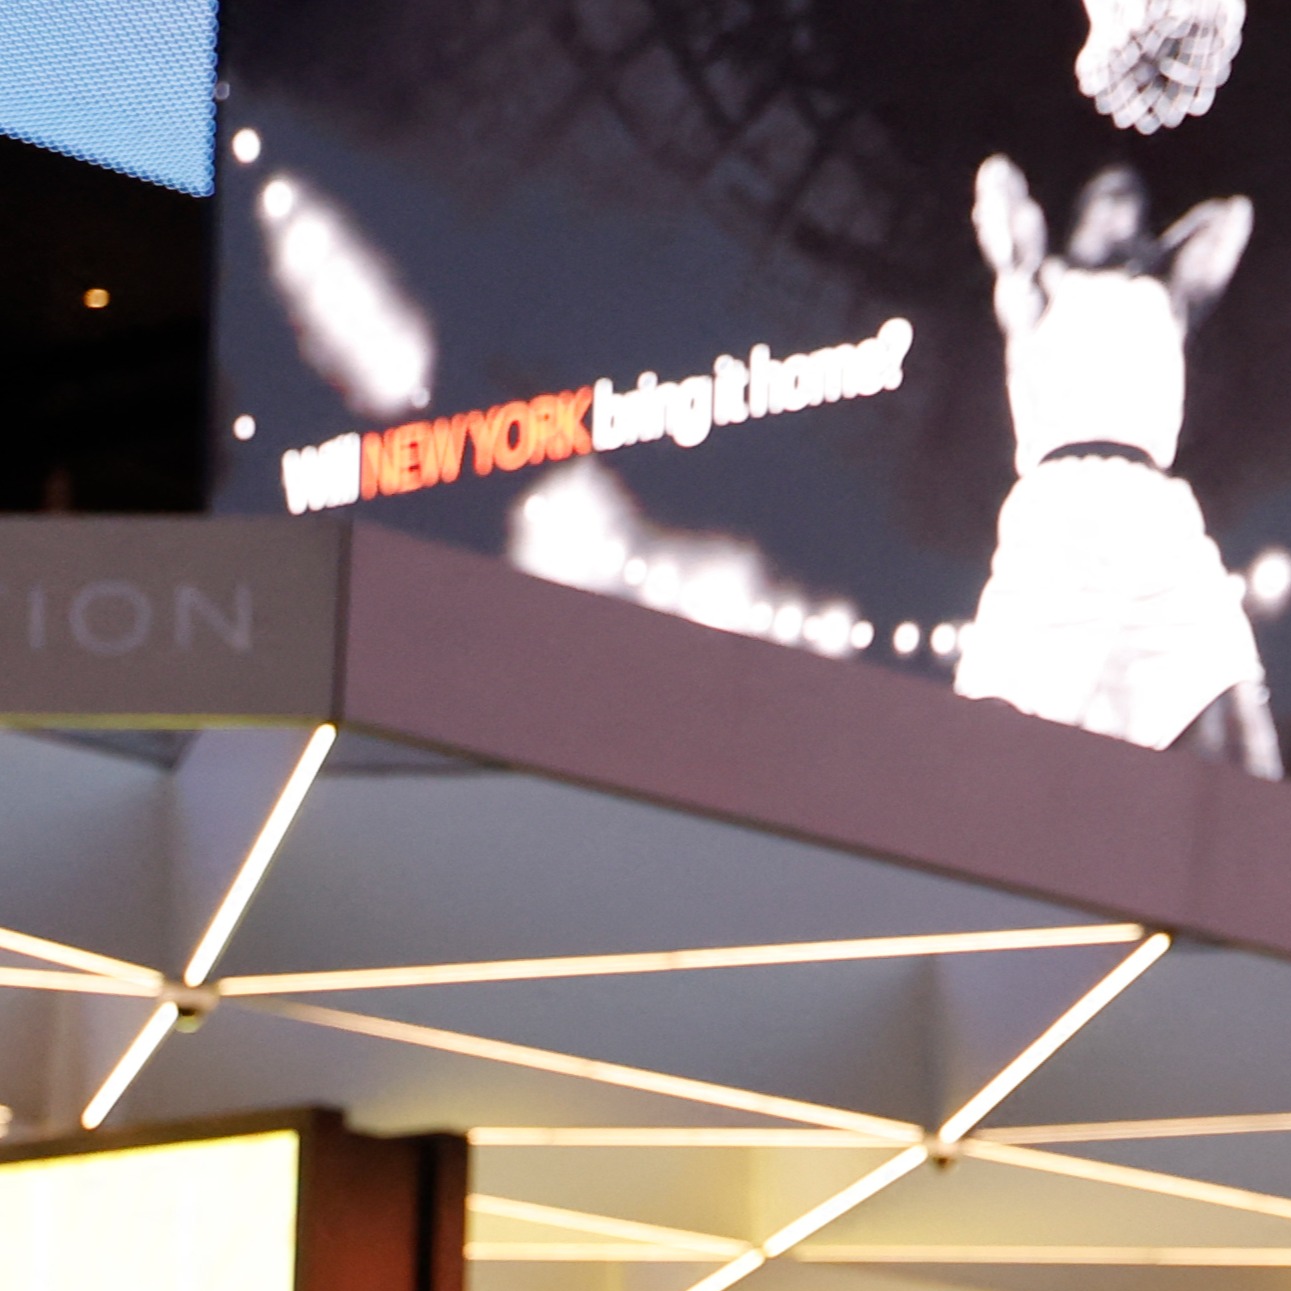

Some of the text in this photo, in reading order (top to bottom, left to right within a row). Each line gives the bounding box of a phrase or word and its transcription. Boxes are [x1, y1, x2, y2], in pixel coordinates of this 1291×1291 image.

[361, 415, 466, 499] NEW
[465, 387, 594, 476] YORK
[593, 372, 712, 447] bring
[713, 355, 748, 425] it
[0, 582, 252, 655] ION
